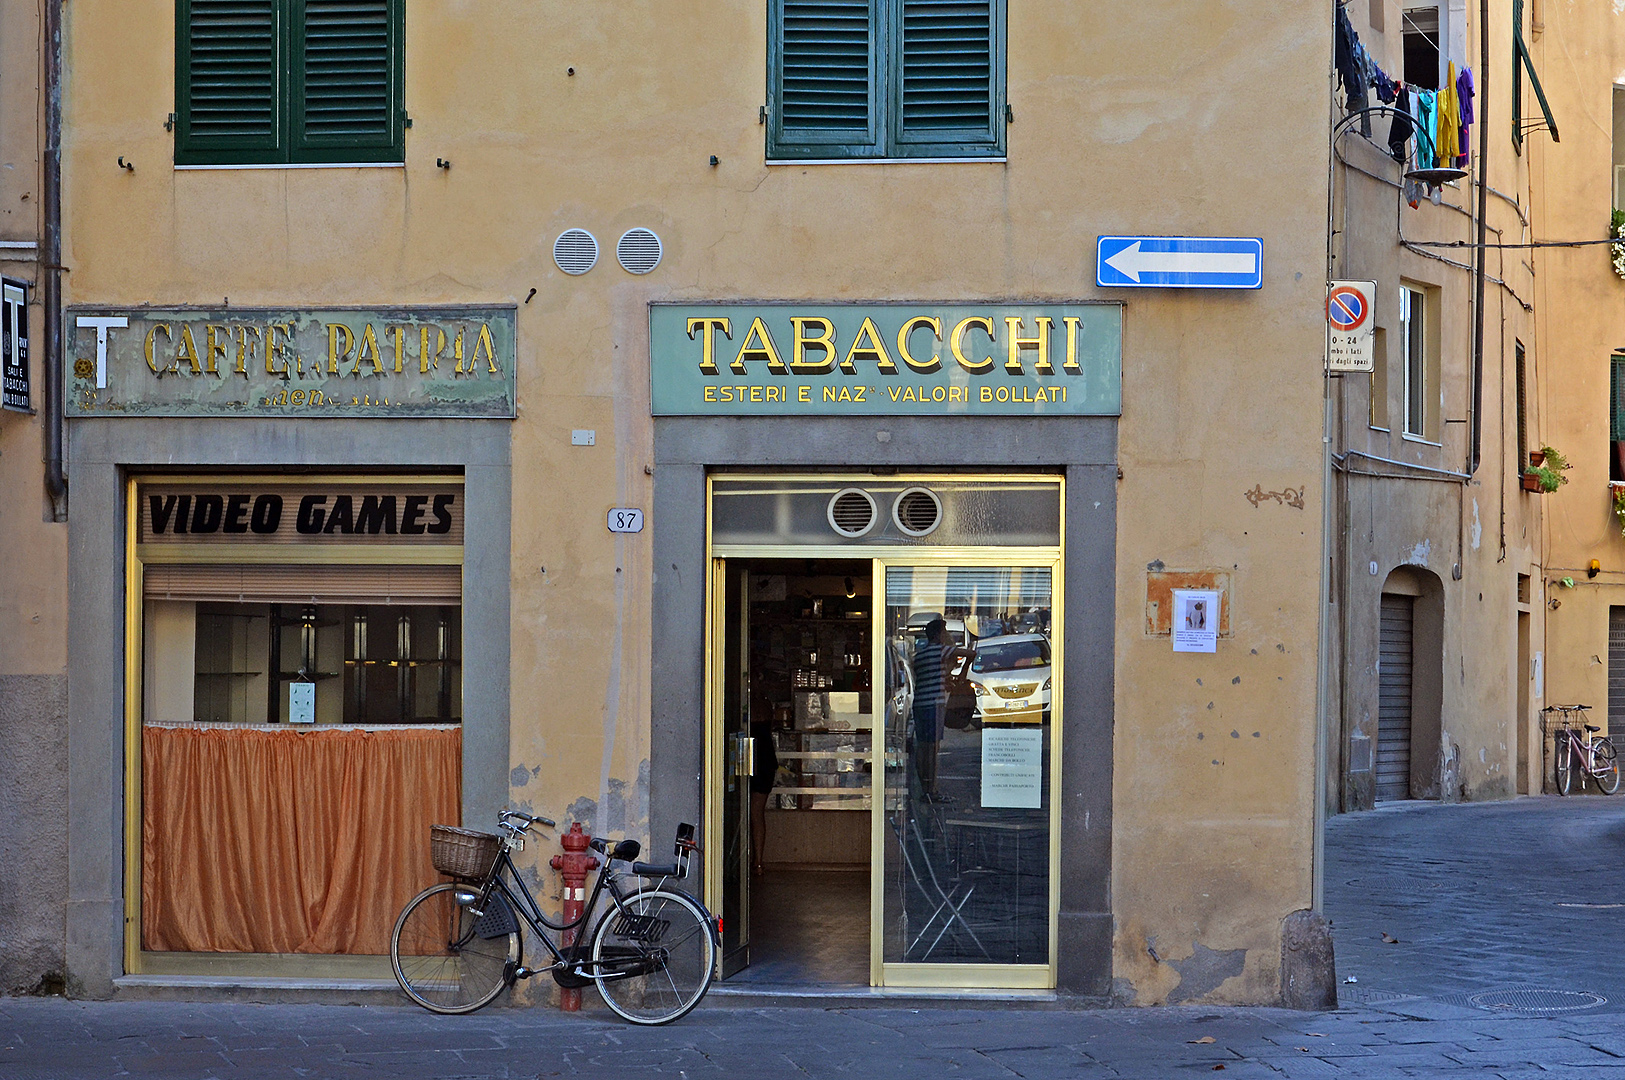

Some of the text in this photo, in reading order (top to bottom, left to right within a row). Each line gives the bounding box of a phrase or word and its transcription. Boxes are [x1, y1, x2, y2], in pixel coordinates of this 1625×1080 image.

[4, 283, 24, 366] T
[1347, 336, 1357, 344] 24
[76, 316, 129, 389] T
[687, 316, 1083, 375] TABACCHI
[704, 386, 787, 402] ESTERI
[798, 386, 810, 402] E
[887, 385, 969, 402] VALORI
[980, 385, 1068, 402] BOLLATI
[148, 494, 455, 534] VIDEO GAMES
[616, 511, 637, 529] 87
